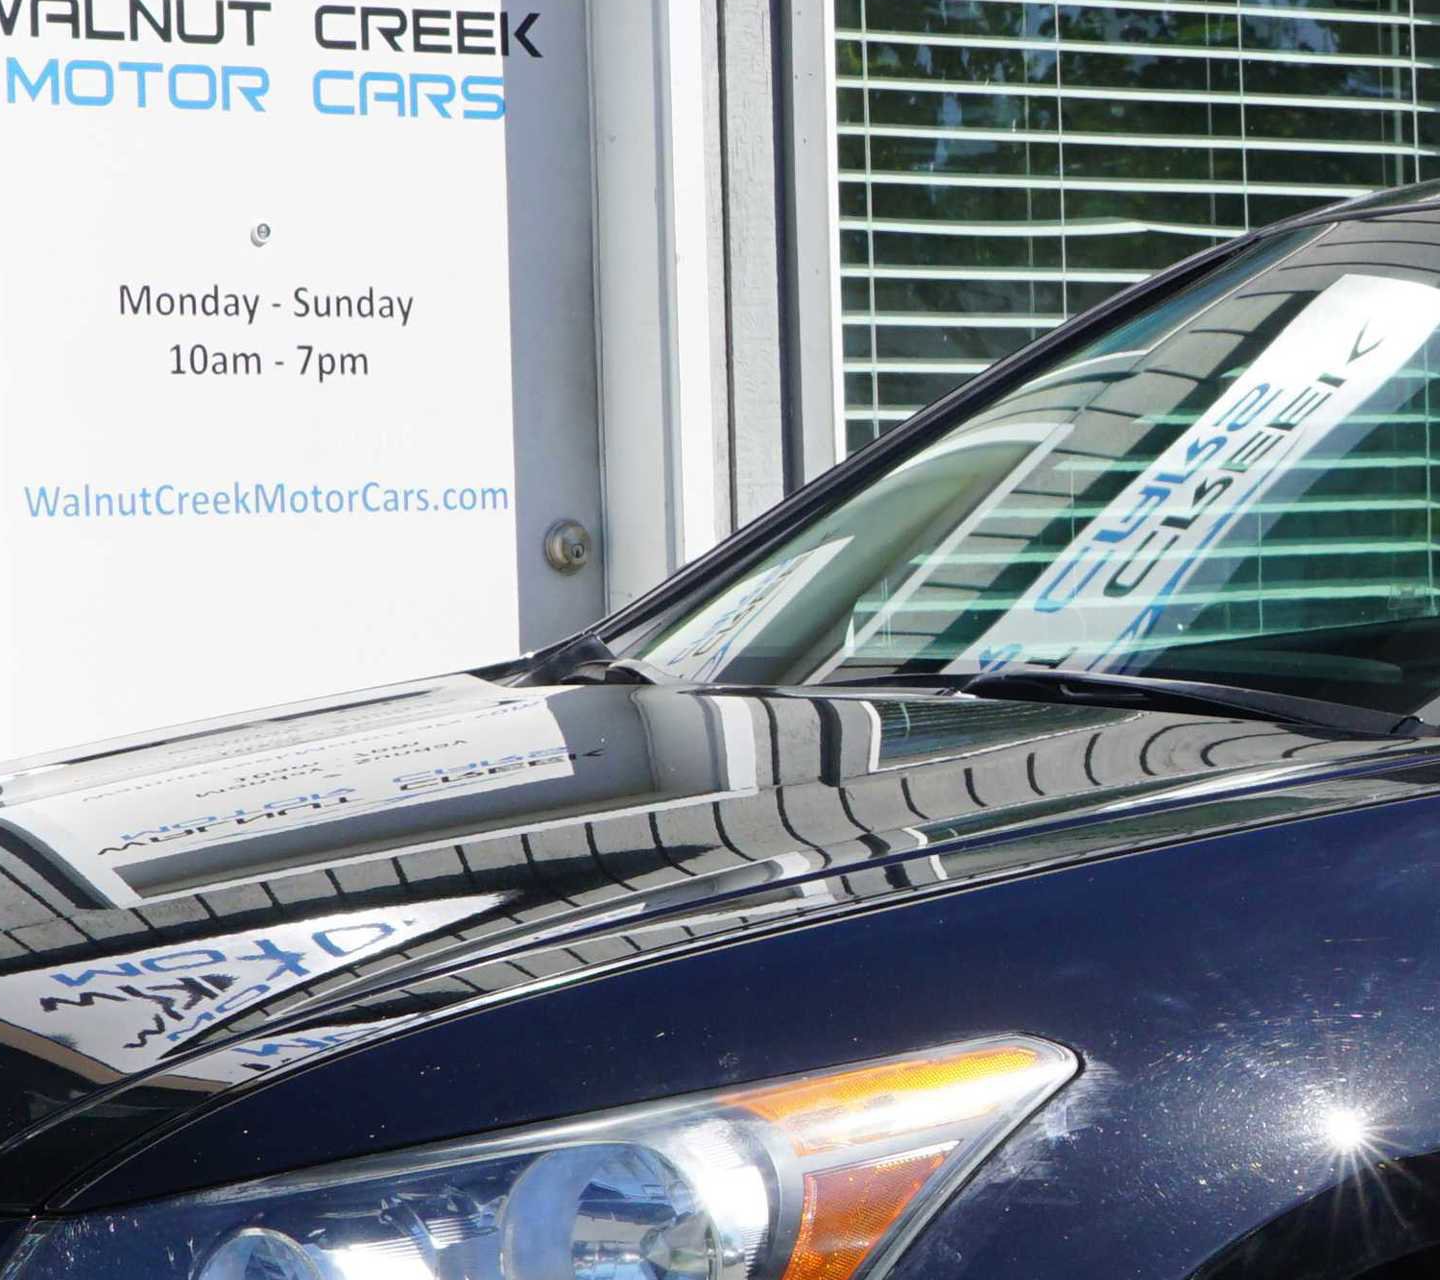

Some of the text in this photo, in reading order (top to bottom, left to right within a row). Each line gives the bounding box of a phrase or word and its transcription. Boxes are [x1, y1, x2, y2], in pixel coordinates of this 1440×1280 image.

[315, 5, 543, 57] CREEK
[6, 57, 508, 121] MOTOR CARS
[119, 284, 260, 325] Monday
[293, 286, 414, 327] Sunday
[169, 344, 262, 376] 10am
[296, 345, 369, 383] 7pm
[24, 481, 509, 519] WalnutCreekMotorCars.com
